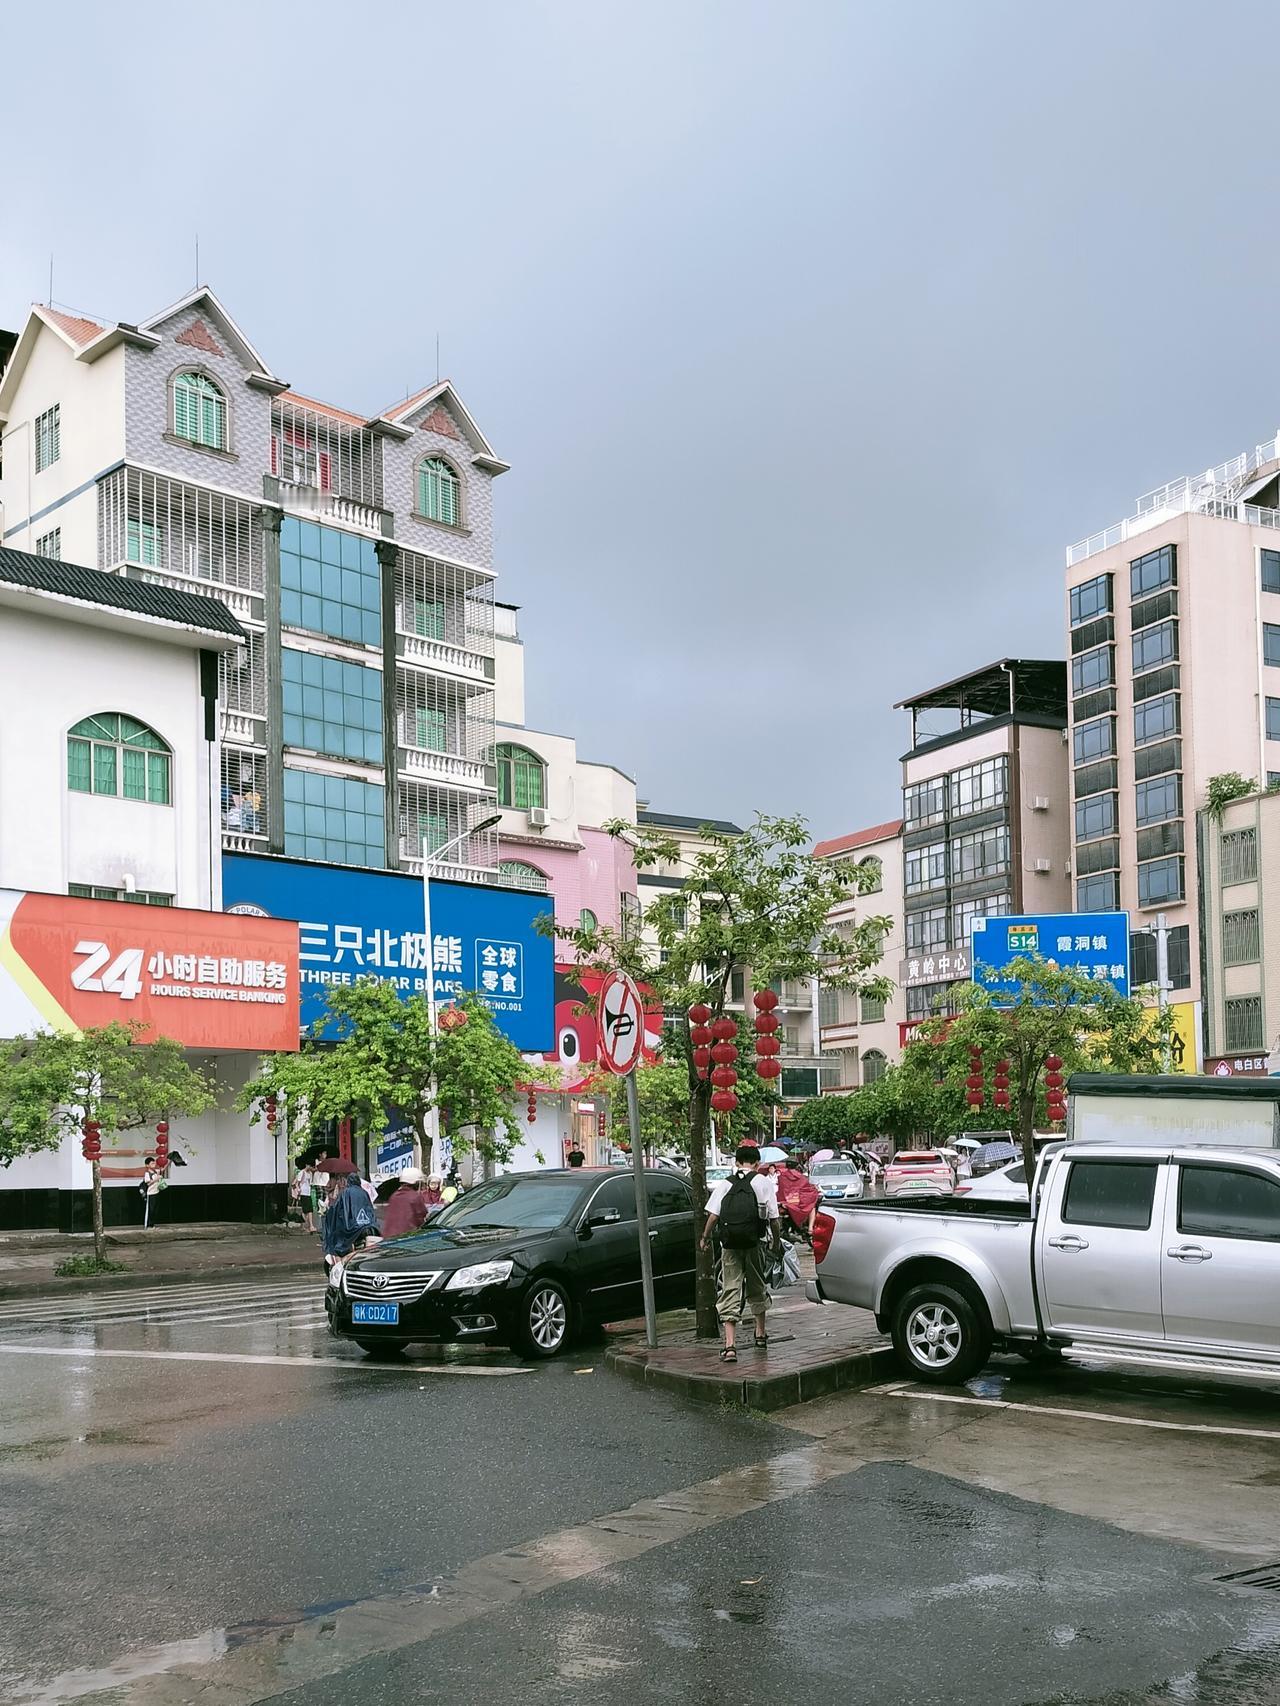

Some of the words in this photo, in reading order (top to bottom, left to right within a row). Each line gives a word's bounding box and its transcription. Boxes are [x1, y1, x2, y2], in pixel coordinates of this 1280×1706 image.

[299, 922, 463, 973] 三只北极熊
[1010, 935, 1037, 948] S14
[1056, 935, 1108, 952] 霞洞镇
[481, 944, 517, 968] 全球
[908, 952, 967, 979] 黄岭中心
[70, 941, 145, 1000] 24
[148, 951, 288, 989] 小时自助服务
[299, 969, 352, 986] THREE
[481, 970, 517, 993] 零食
[151, 984, 191, 998] HOURS
[192, 987, 238, 1001] SERVICE
[239, 991, 286, 1004] BANKING
